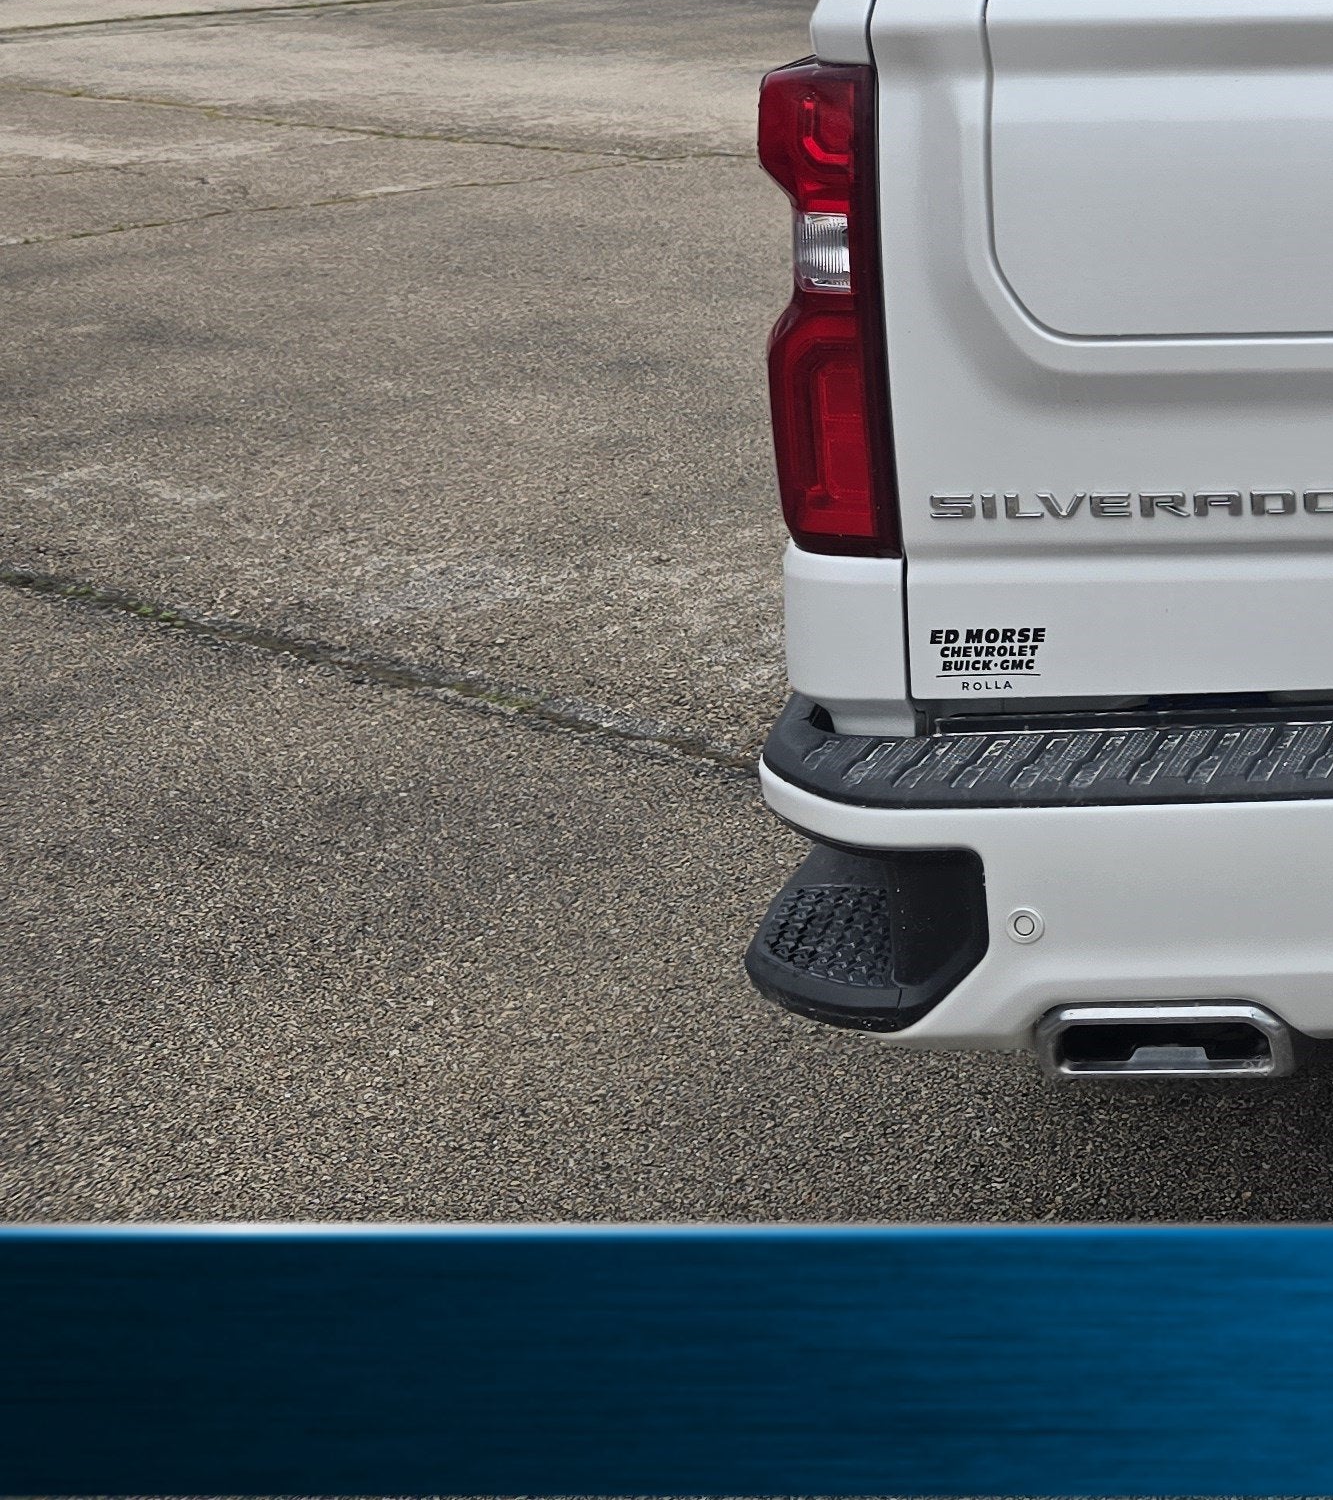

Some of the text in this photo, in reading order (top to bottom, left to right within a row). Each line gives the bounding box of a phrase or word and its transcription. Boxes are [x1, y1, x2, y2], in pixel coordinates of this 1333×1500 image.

[929, 627, 1047, 645] ED MORSE
[939, 644, 1039, 659] CHEVROLET
[961, 680, 1013, 691] ROLLA
